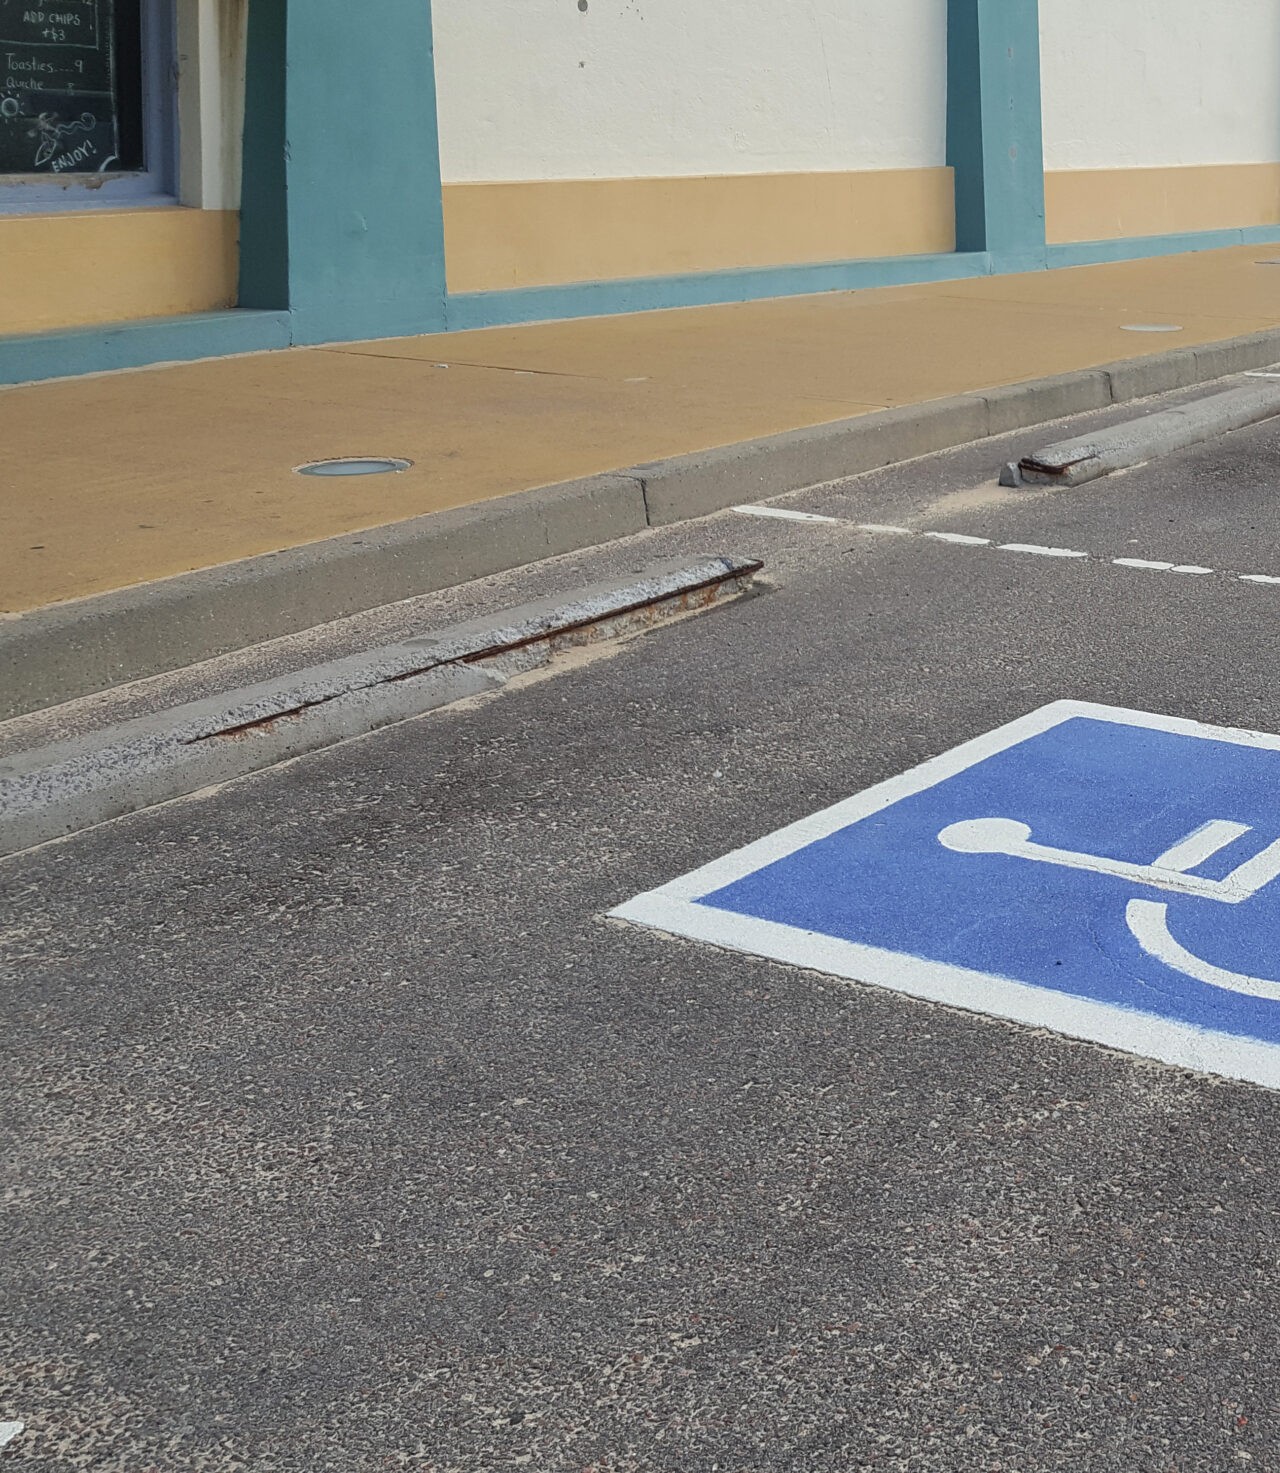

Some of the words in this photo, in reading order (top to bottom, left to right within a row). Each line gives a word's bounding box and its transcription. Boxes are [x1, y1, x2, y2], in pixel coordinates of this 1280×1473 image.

[23, 10, 45, 23] ADD
[48, 13, 81, 25] CHIPS
[51, 139, 97, 173] ENJOY!
